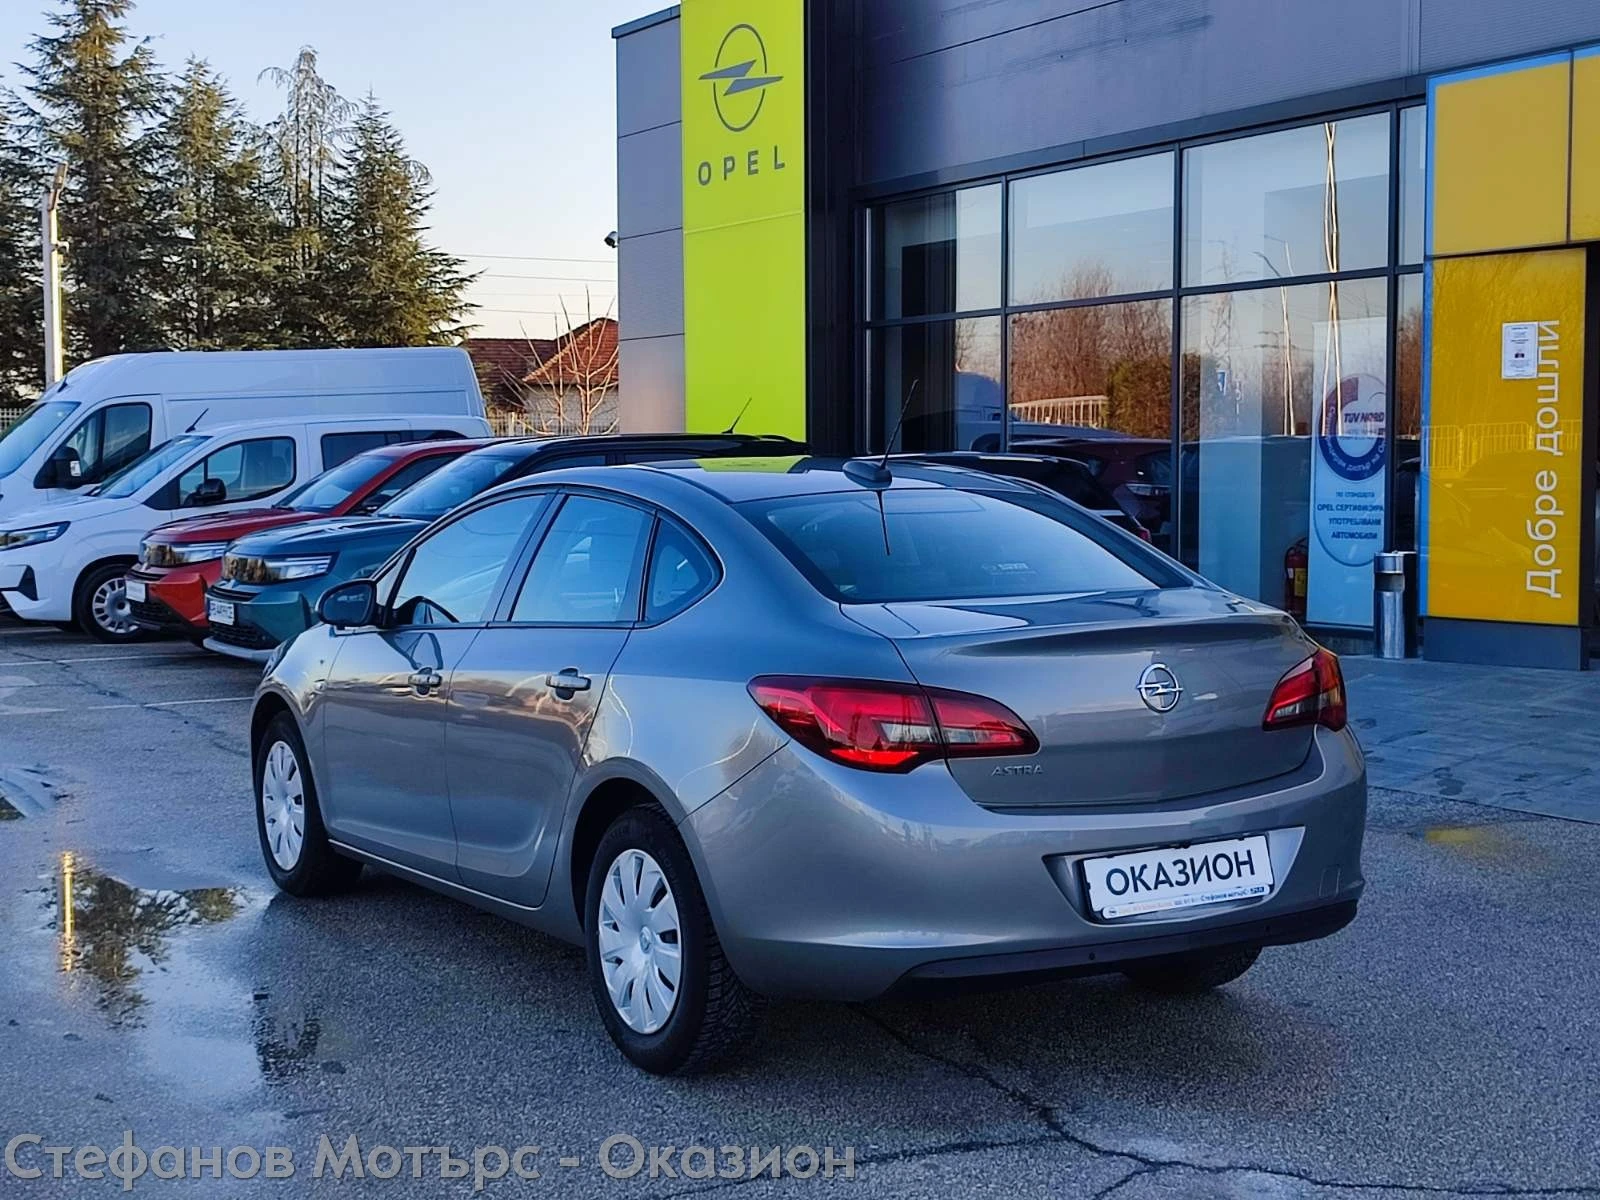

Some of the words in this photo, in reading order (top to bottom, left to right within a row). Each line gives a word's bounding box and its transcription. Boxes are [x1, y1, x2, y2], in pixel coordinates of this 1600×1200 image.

[698, 145, 785, 186] OPEL
[1536, 320, 1563, 456] дошли
[1317, 503, 1335, 511] OPEL
[1331, 531, 1378, 539] АВТОМОБИЛИ
[1526, 470, 1564, 599] Добре
[991, 764, 1044, 777] ASTRA
[1105, 849, 1256, 896] ОКАЗИОН
